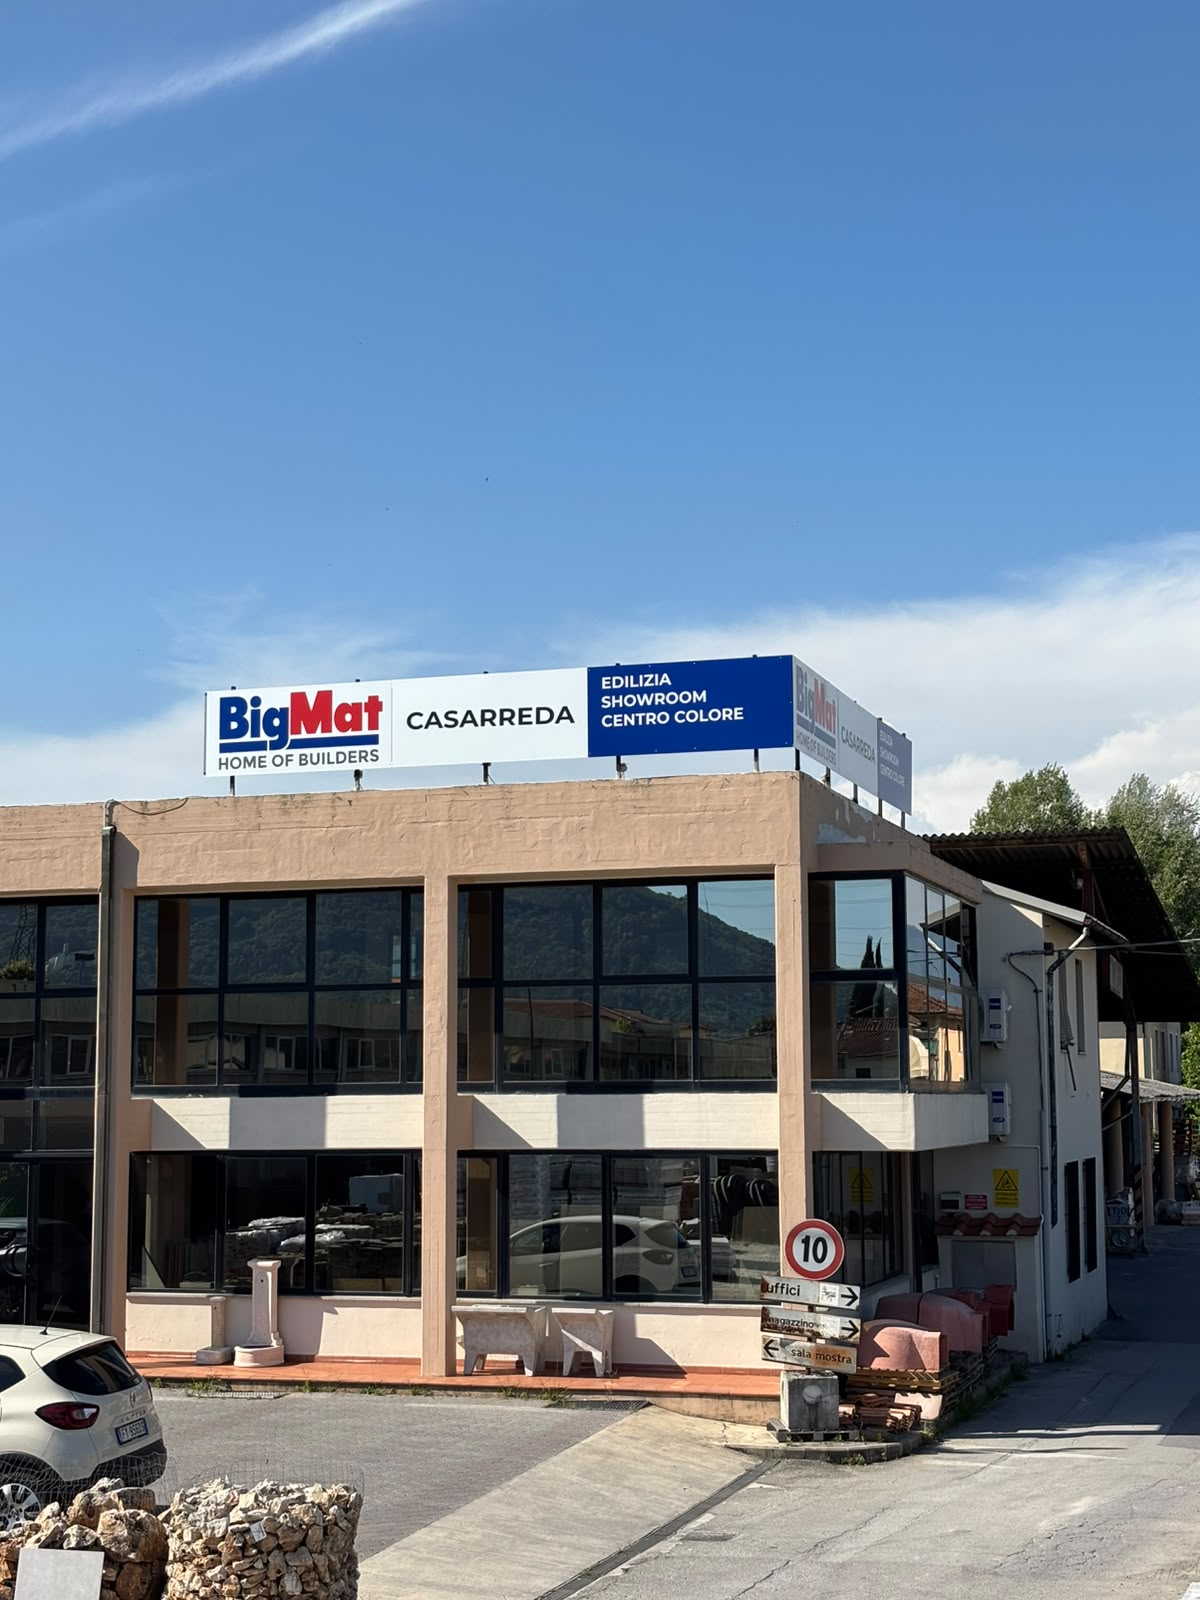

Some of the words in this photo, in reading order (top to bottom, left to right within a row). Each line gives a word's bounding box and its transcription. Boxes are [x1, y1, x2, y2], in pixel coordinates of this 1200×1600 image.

[601, 673, 672, 690] EDILIZIA
[601, 690, 707, 709] SHOWROOM
[796, 665, 836, 735] BigMat
[219, 690, 383, 750] BigMat
[406, 705, 576, 730] CASARREDA
[601, 711, 670, 728] CENTRO
[674, 707, 744, 725] COLORE
[840, 725, 876, 765] CASARREDA
[218, 755, 267, 771] HOME
[271, 753, 294, 768] OF
[298, 749, 380, 767] BUILDERS
[801, 1235, 828, 1264] 10
[766, 1282, 801, 1297] uffici
[791, 1348, 812, 1359] sala
[815, 1352, 852, 1365] mostra
